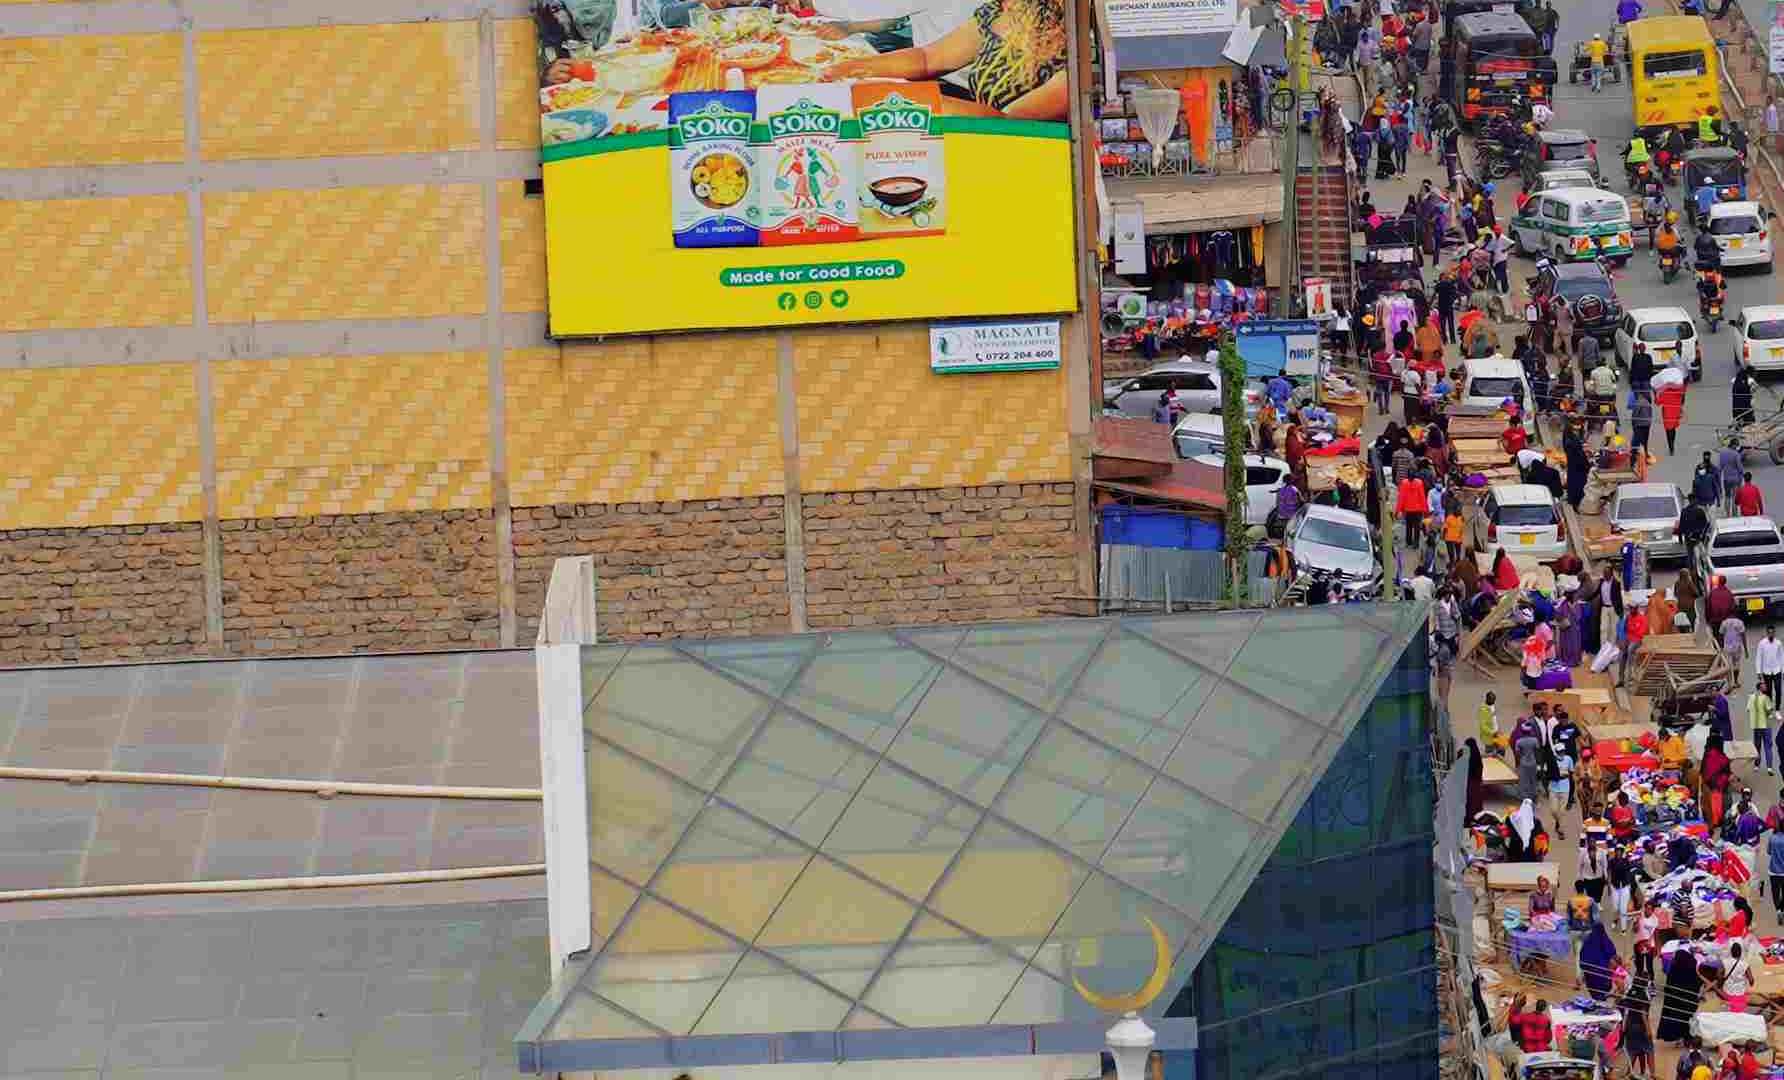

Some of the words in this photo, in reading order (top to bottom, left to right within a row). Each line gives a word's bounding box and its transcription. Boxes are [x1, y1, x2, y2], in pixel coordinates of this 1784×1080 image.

[1151, 1, 1195, 9] ASSURANCE
[683, 118, 746, 138] SOKO
[774, 115, 837, 135] SOKO
[863, 110, 926, 131] SOKO
[729, 270, 774, 285] Made
[778, 269, 803, 281] for
[808, 266, 850, 280] Good
[855, 264, 896, 277] Food
[975, 325, 1056, 341] MAGNATE
